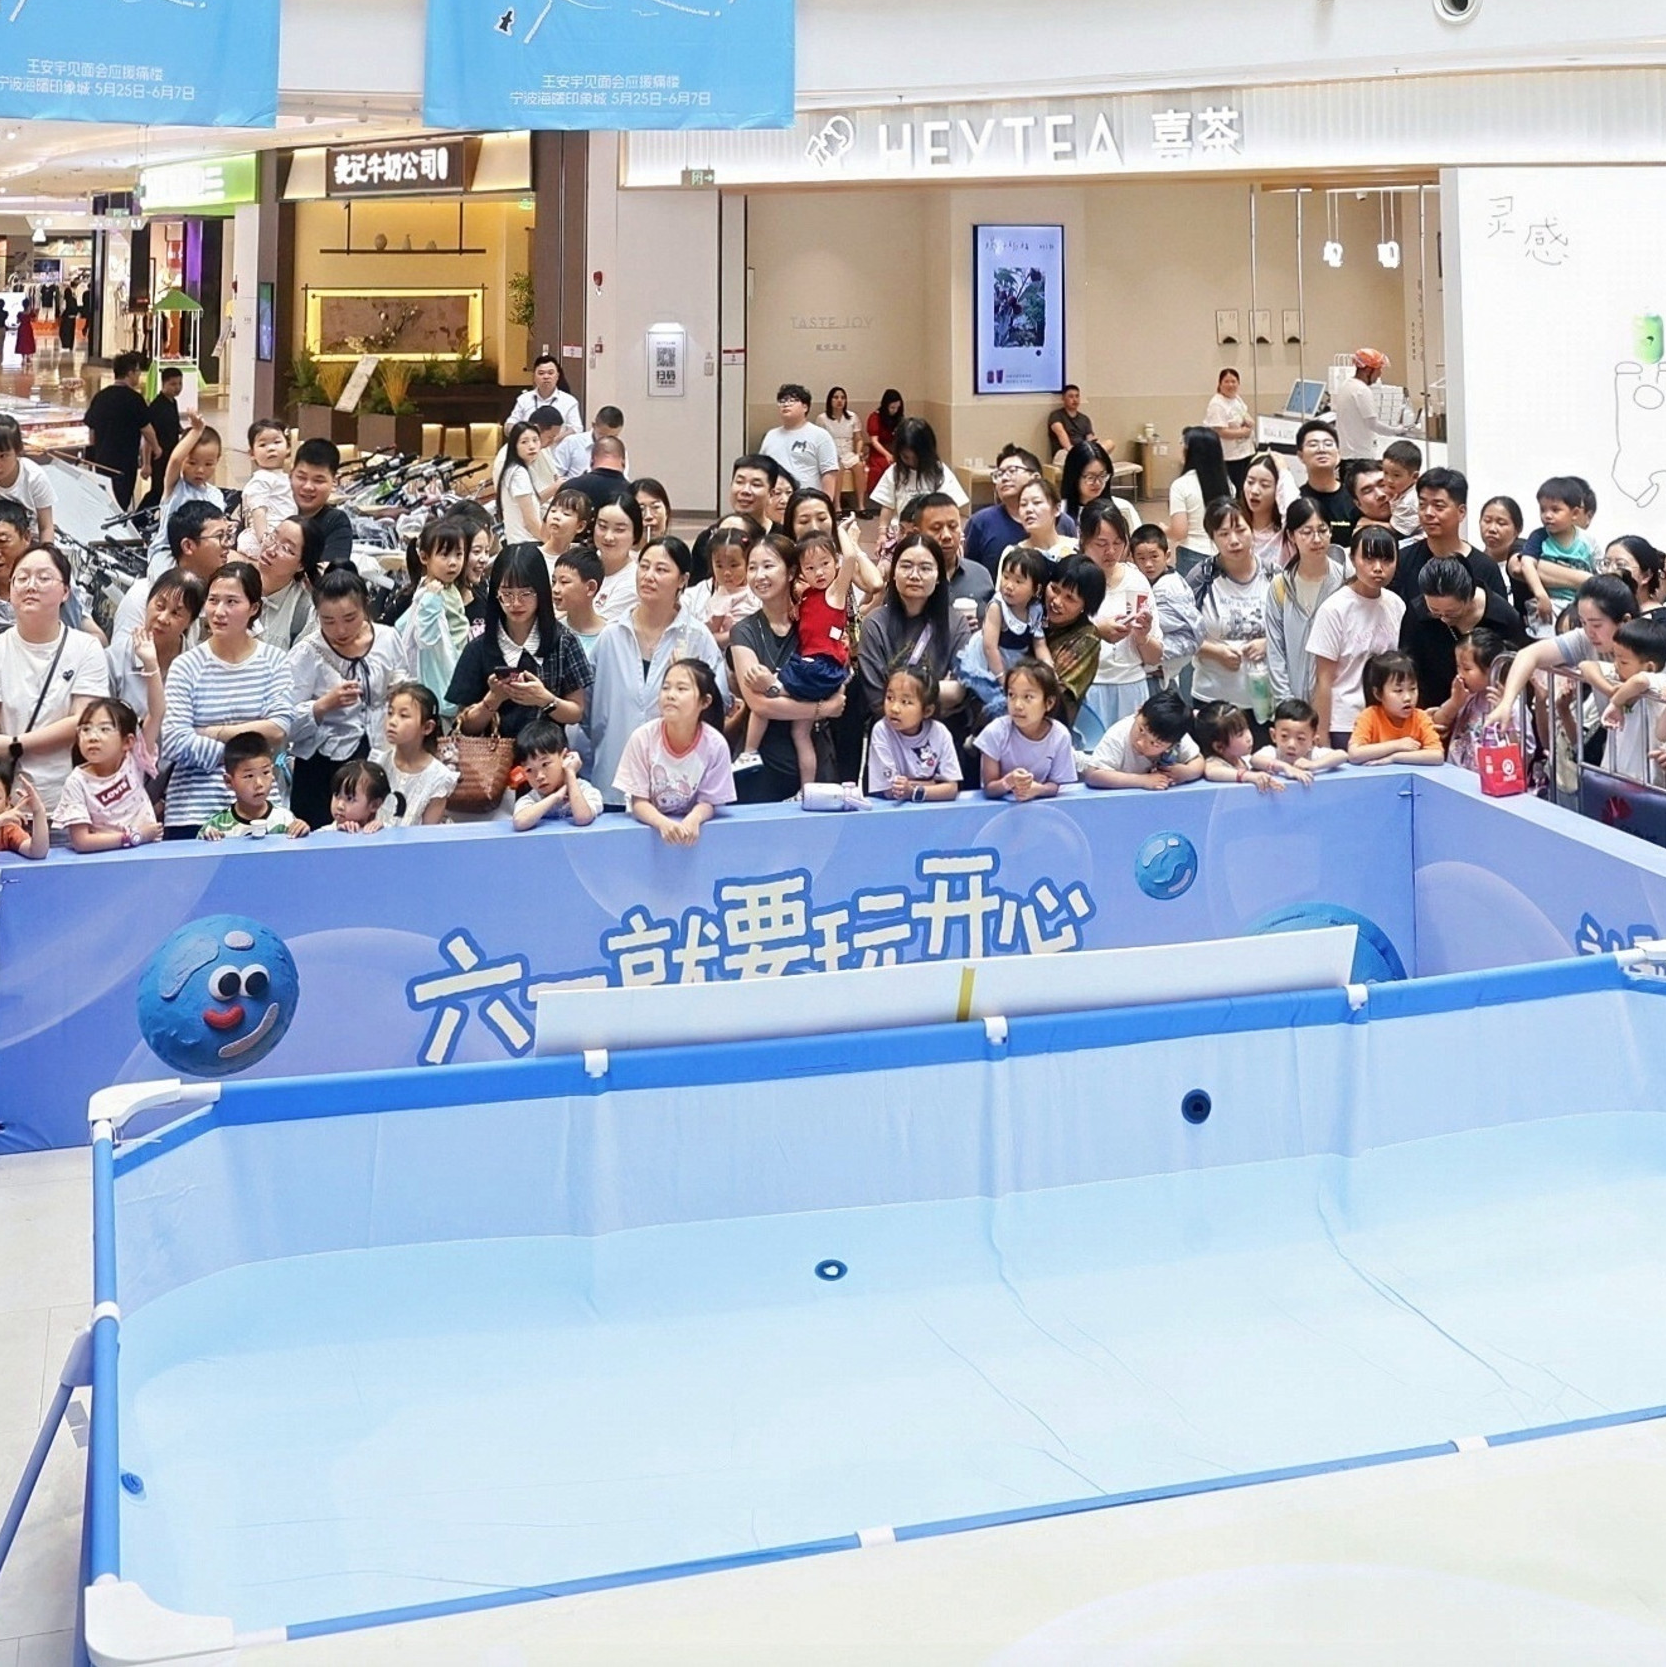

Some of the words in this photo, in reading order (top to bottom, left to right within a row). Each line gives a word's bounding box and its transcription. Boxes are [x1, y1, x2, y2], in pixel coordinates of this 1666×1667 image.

[26, 57, 165, 83] 王安宇见面会应援痛楼
[93, 80, 196, 102] 5月25日-6月7日
[541, 73, 681, 91] 王安宇见面会应援痛楼
[610, 91, 712, 108] 5月25日-6月7日
[877, 112, 1126, 170] HEYTEA
[1150, 106, 1243, 158] 喜茶
[1486, 195, 1570, 266] 灵感
[790, 315, 837, 330] TASTE
[842, 315, 874, 330] JOY
[656, 369, 677, 381] 扫码
[411, 854, 1092, 1066] 六一就要玩开心
